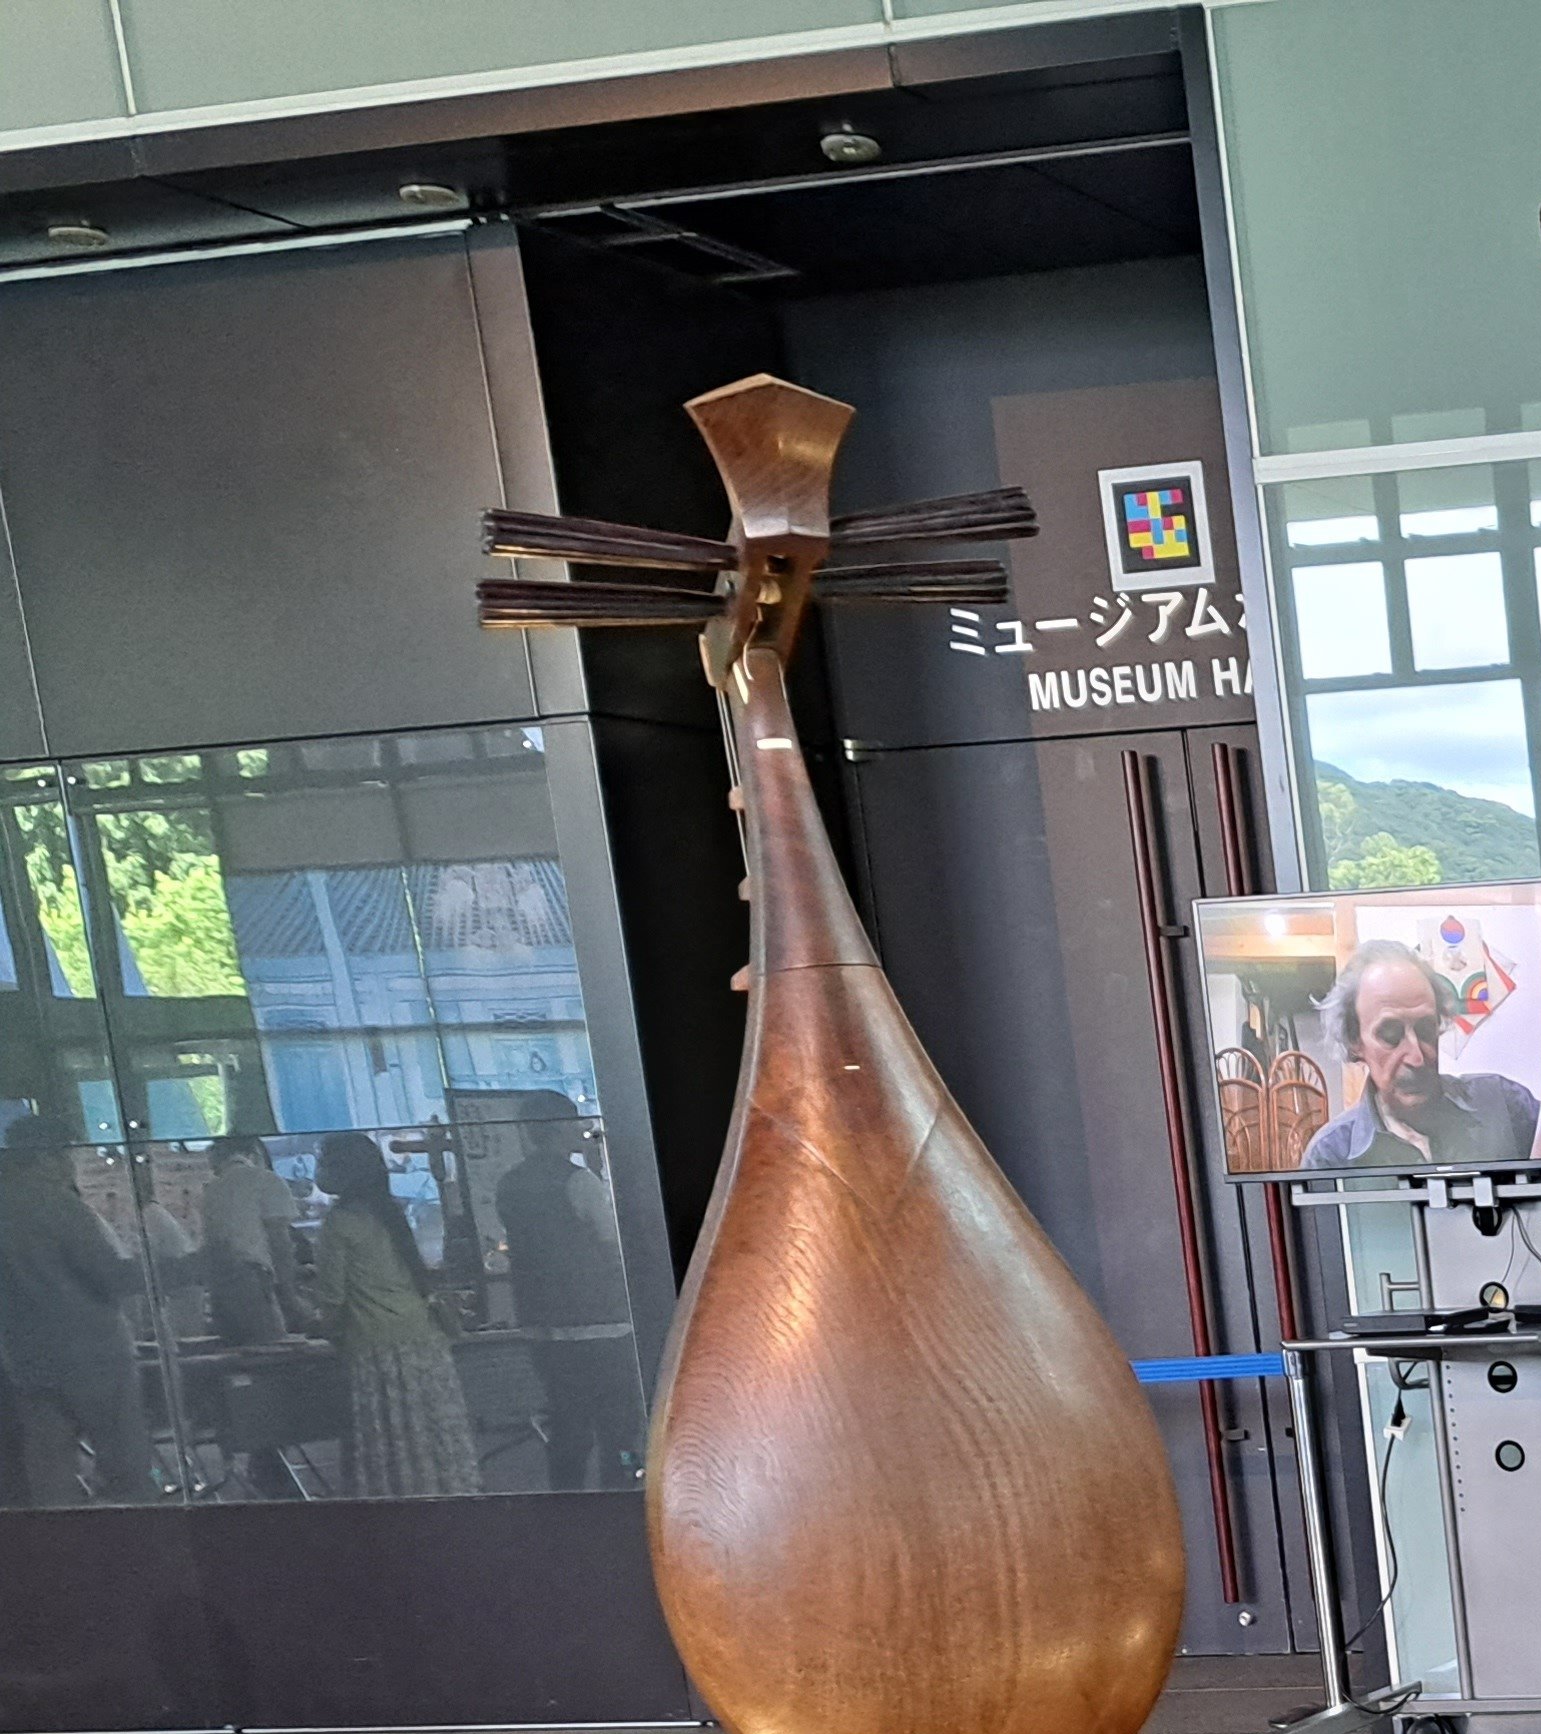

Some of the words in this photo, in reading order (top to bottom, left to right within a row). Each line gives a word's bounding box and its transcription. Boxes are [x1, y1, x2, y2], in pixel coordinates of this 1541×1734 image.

[950, 587, 1247, 656] ミュージアム
[1028, 660, 1197, 711] MUSEUM
